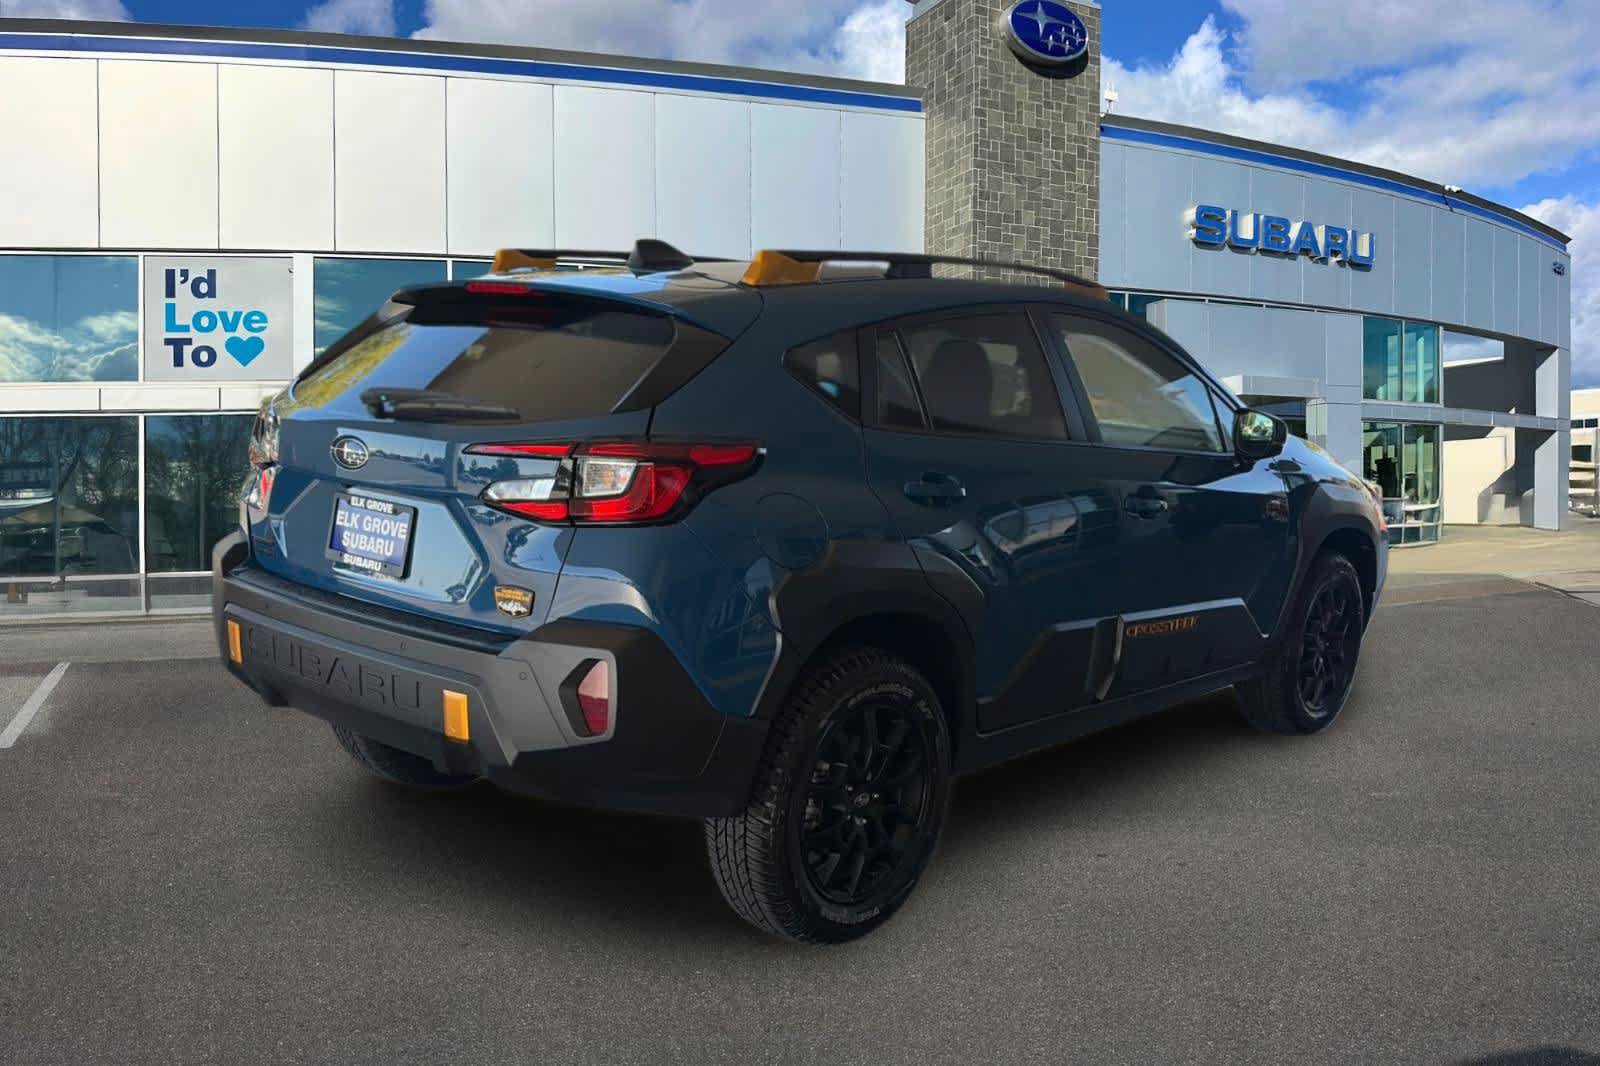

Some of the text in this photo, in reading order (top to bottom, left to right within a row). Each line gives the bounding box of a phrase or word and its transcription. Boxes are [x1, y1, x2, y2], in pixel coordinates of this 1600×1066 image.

[1192, 204, 1376, 270] SUBARU
[165, 268, 217, 299] I’d
[165, 302, 268, 333] Love
[163, 337, 217, 368] To
[350, 495, 394, 513] ELK GROVE
[336, 510, 408, 539] ELK GROVE
[341, 531, 394, 557] SUBARU
[343, 553, 382, 571] SUBARU
